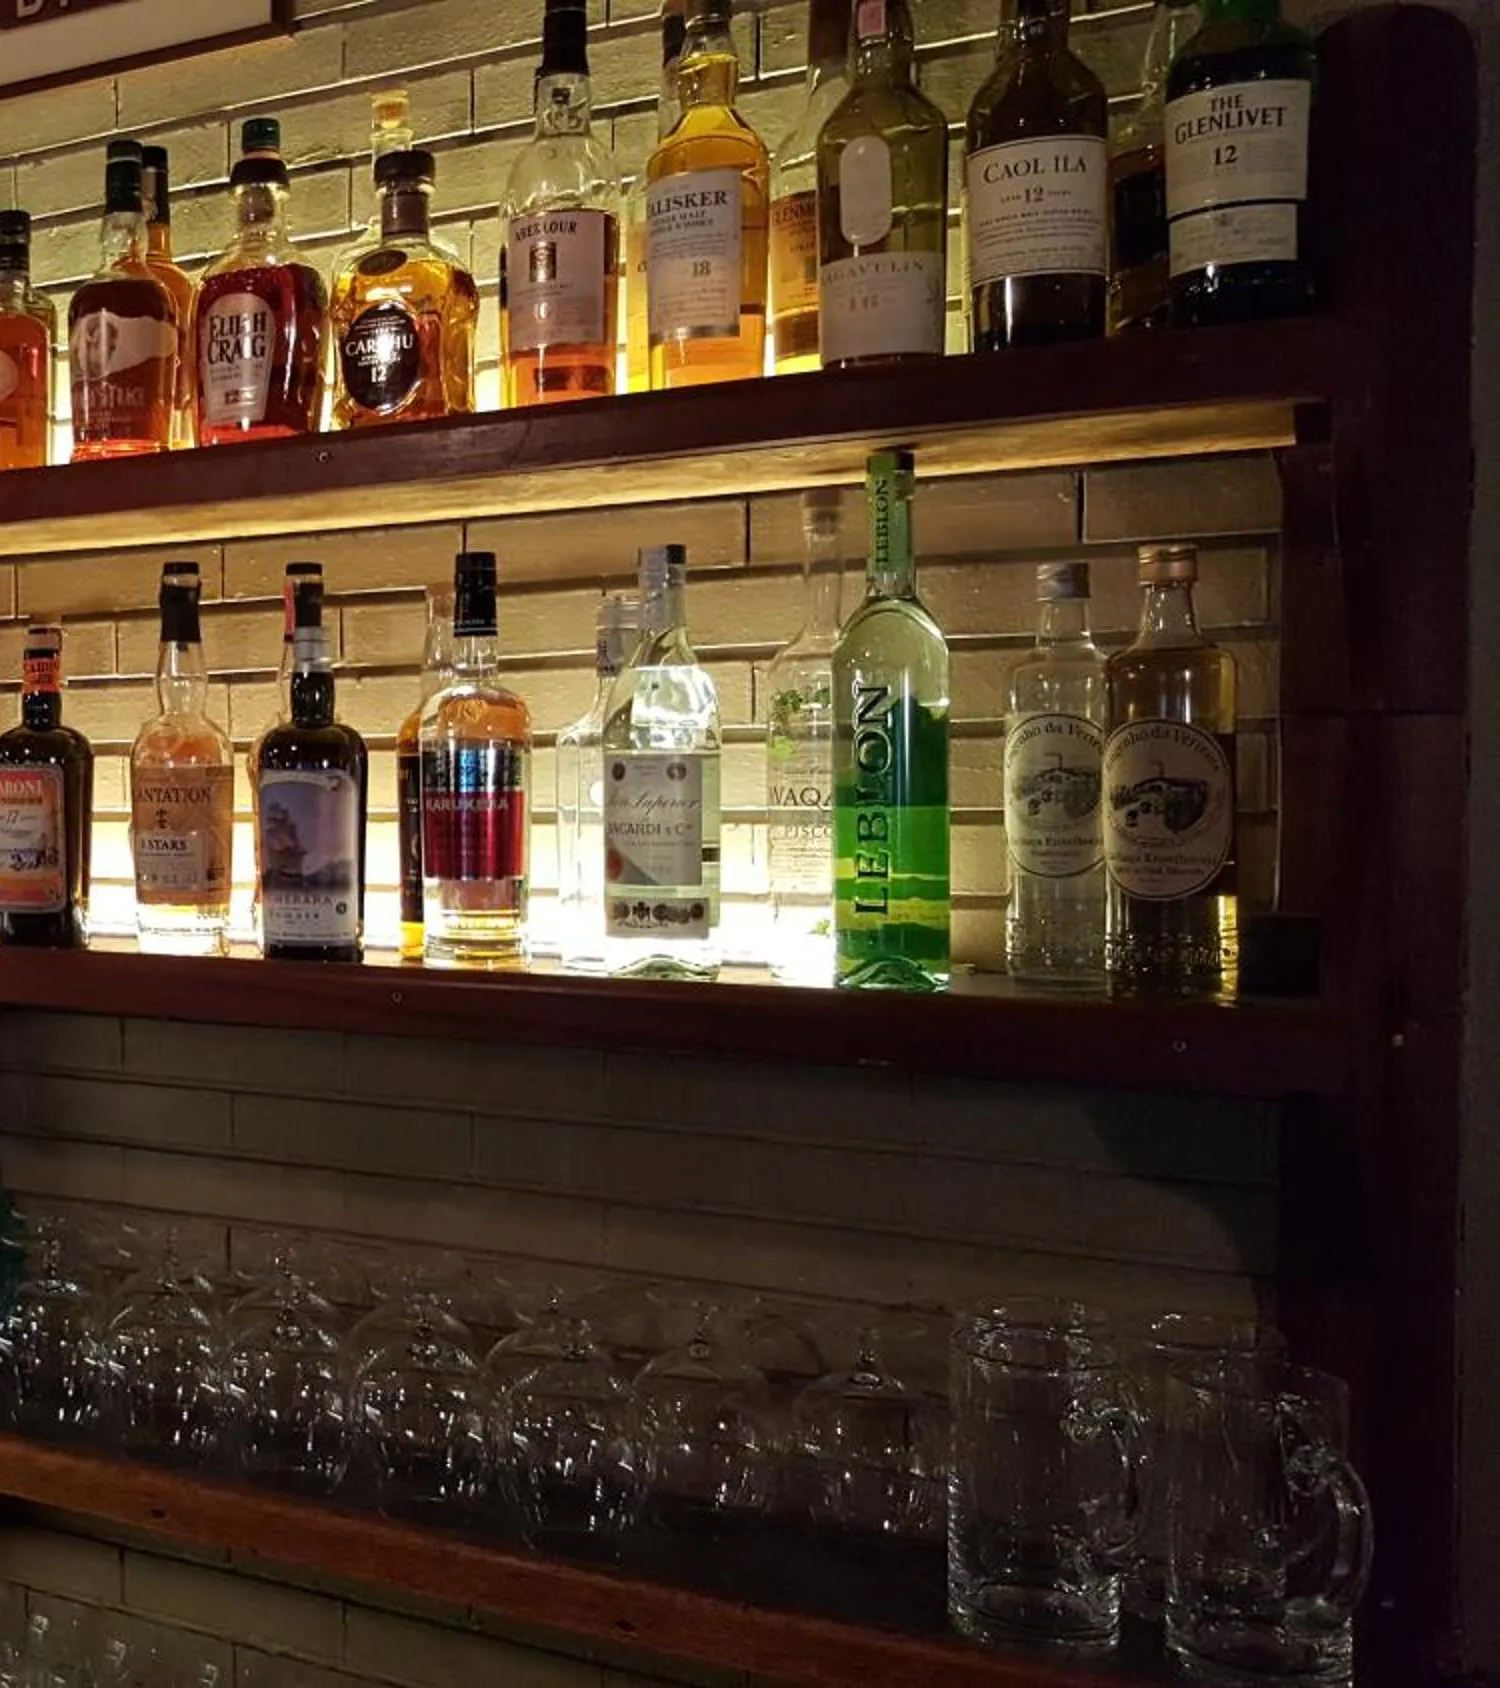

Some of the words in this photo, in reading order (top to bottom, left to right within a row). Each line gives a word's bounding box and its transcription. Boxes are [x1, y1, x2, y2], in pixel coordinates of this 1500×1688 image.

[1211, 94, 1244, 112] THE
[1175, 106, 1289, 144] GLENLIVET
[1214, 144, 1240, 166] 12
[983, 158, 1046, 184] CAOL
[1054, 155, 1088, 173] ILA
[647, 189, 729, 218] ALISKER
[1024, 186, 1044, 204] 12
[692, 260, 712, 278] 18
[209, 311, 267, 339] ELIJH
[208, 336, 266, 366] CRAG
[345, 334, 414, 357] CARHU
[370, 366, 388, 384] 12
[875, 479, 889, 563] LEBLON
[132, 786, 212, 804] ANTATION
[854, 685, 893, 916] LEBLON
[148, 839, 188, 851] STARS
